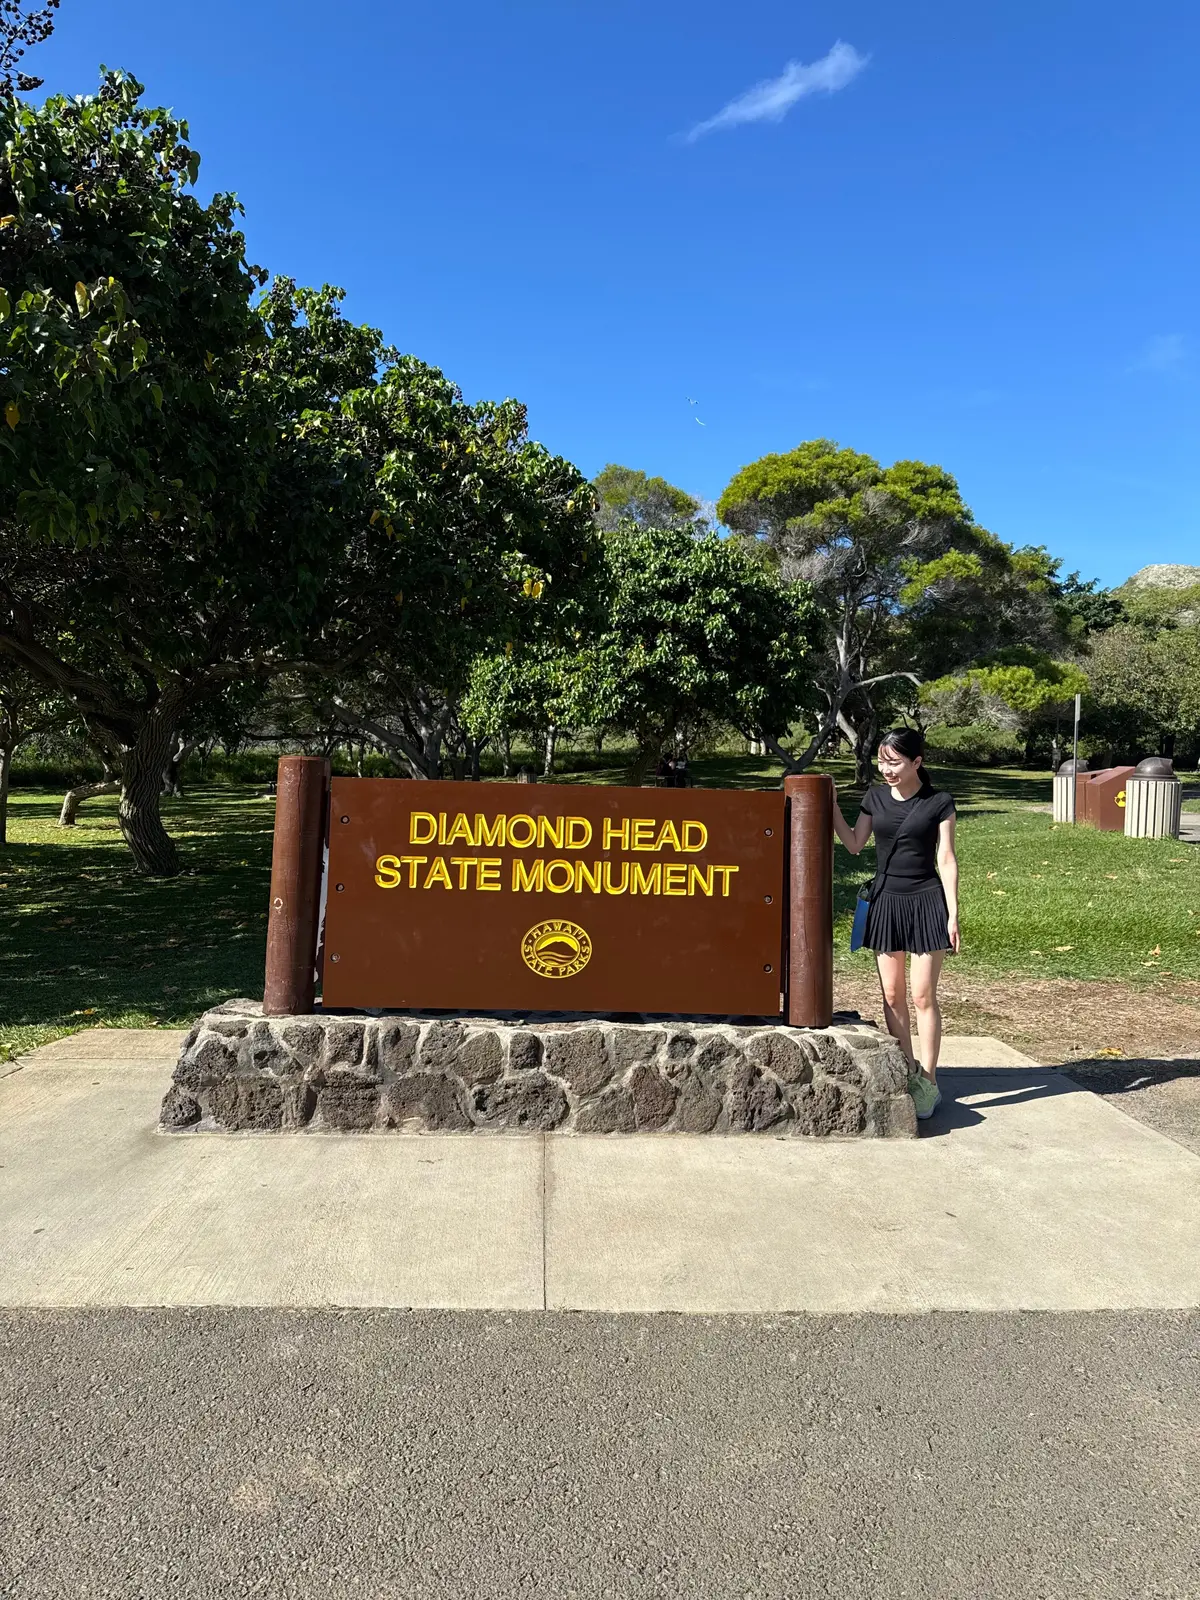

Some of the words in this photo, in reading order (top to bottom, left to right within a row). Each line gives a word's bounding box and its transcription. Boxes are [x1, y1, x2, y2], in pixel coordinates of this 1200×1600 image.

[409, 811, 593, 850] DIAMOND
[602, 818, 708, 853] HEAD
[374, 854, 503, 891] STATE
[511, 858, 740, 897] MONUMENT
[524, 944, 553, 975] STATE
[559, 945, 590, 976] PARKS
